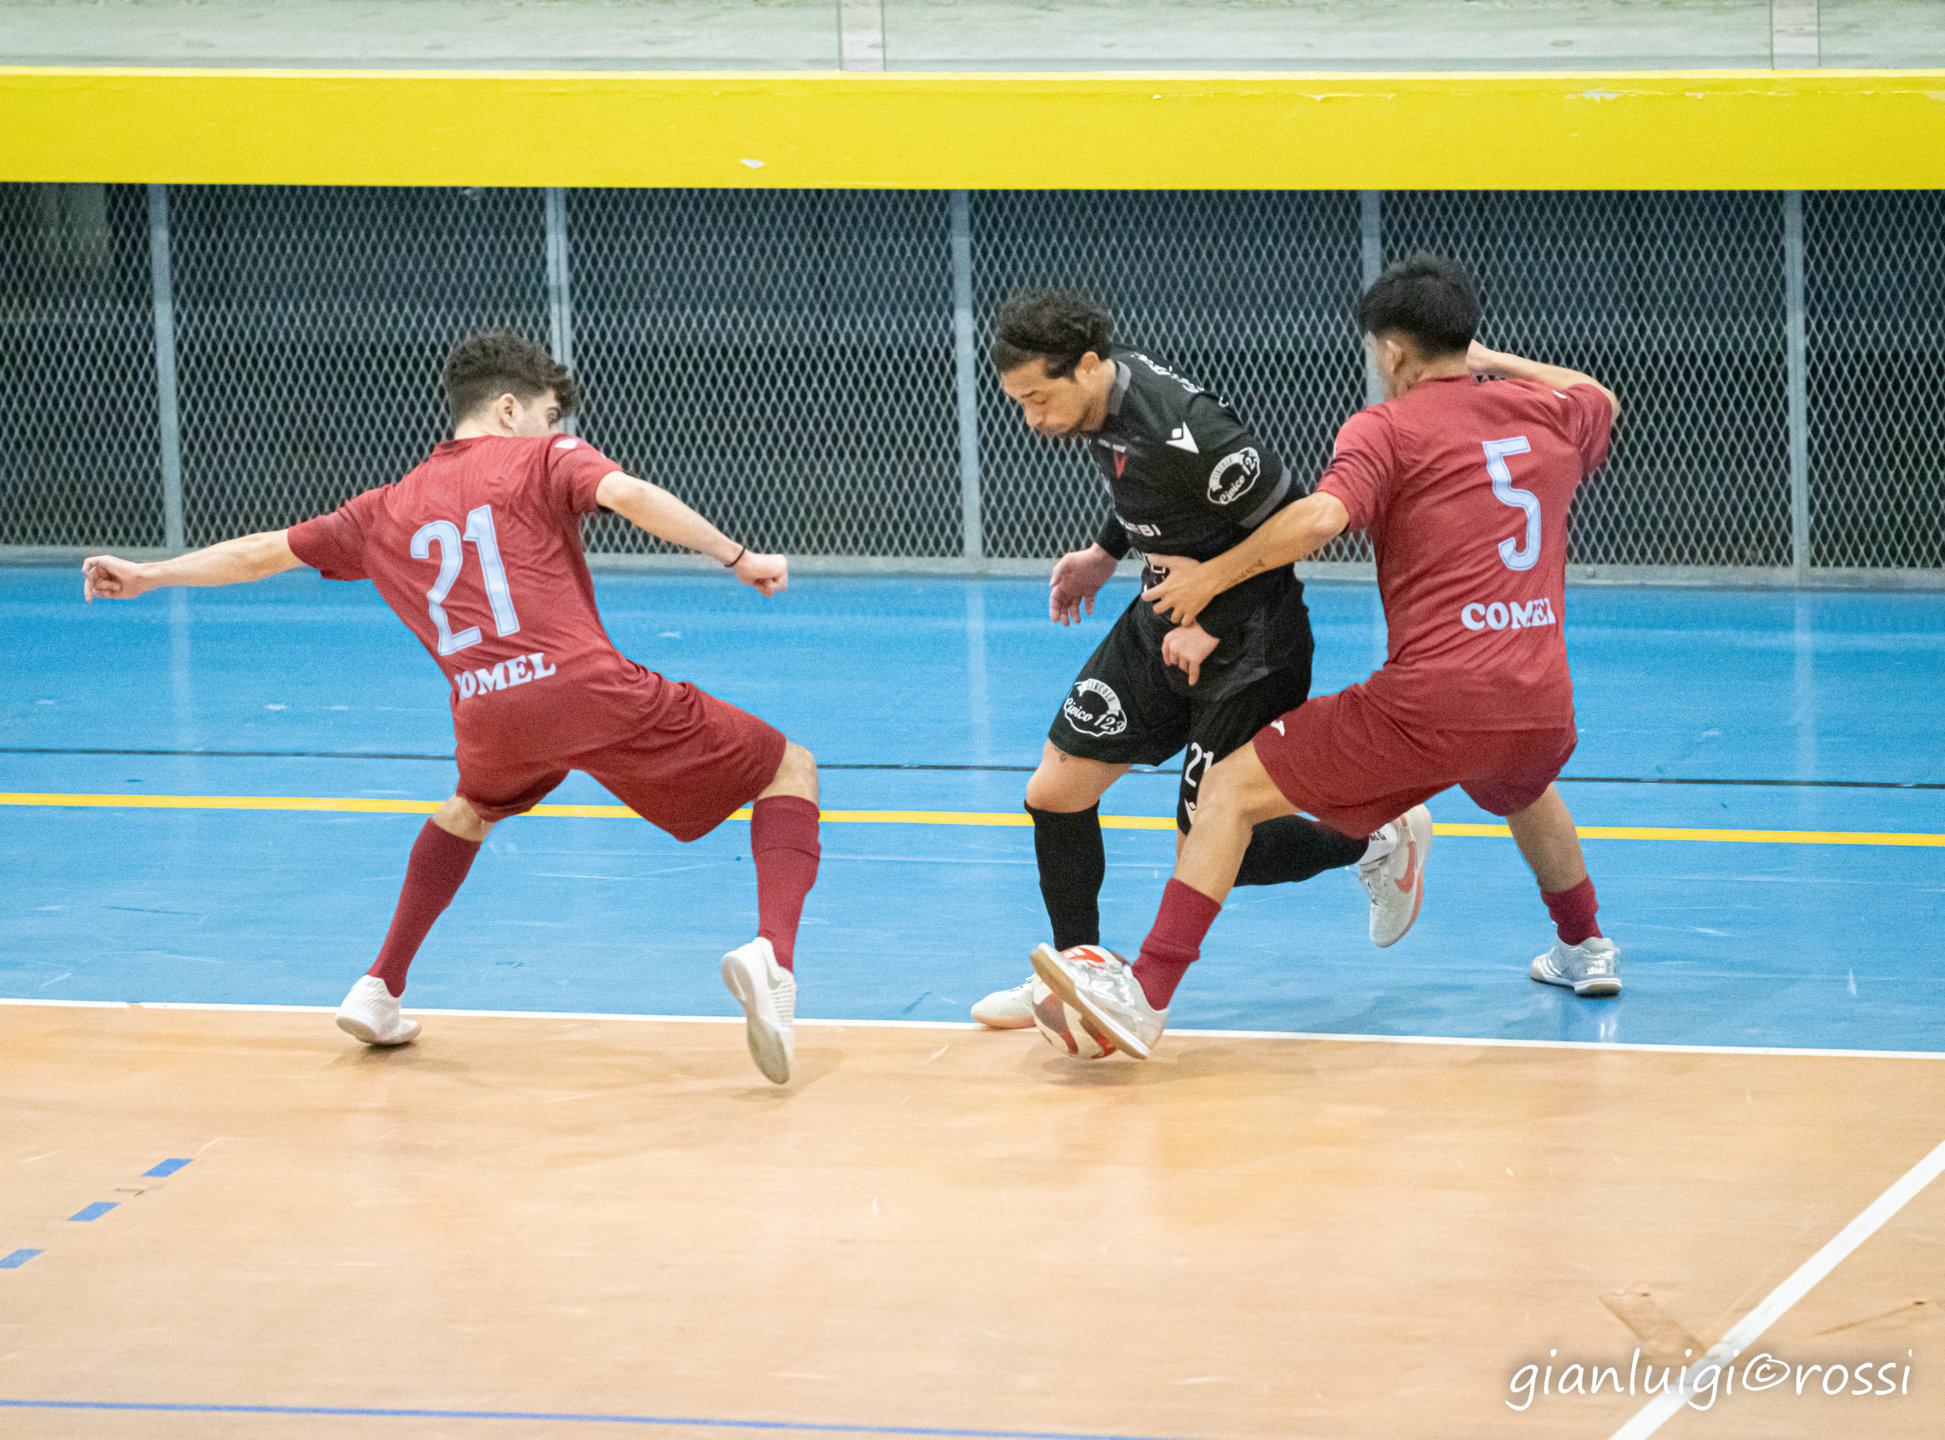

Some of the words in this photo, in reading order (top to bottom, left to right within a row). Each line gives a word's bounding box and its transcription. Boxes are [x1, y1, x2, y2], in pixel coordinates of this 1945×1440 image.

[1482, 436, 1541, 571] 5
[410, 504, 520, 656] 21
[454, 652, 556, 700] OMEL
[1063, 697, 1093, 722] Civico
[1184, 741, 1214, 788] 21
